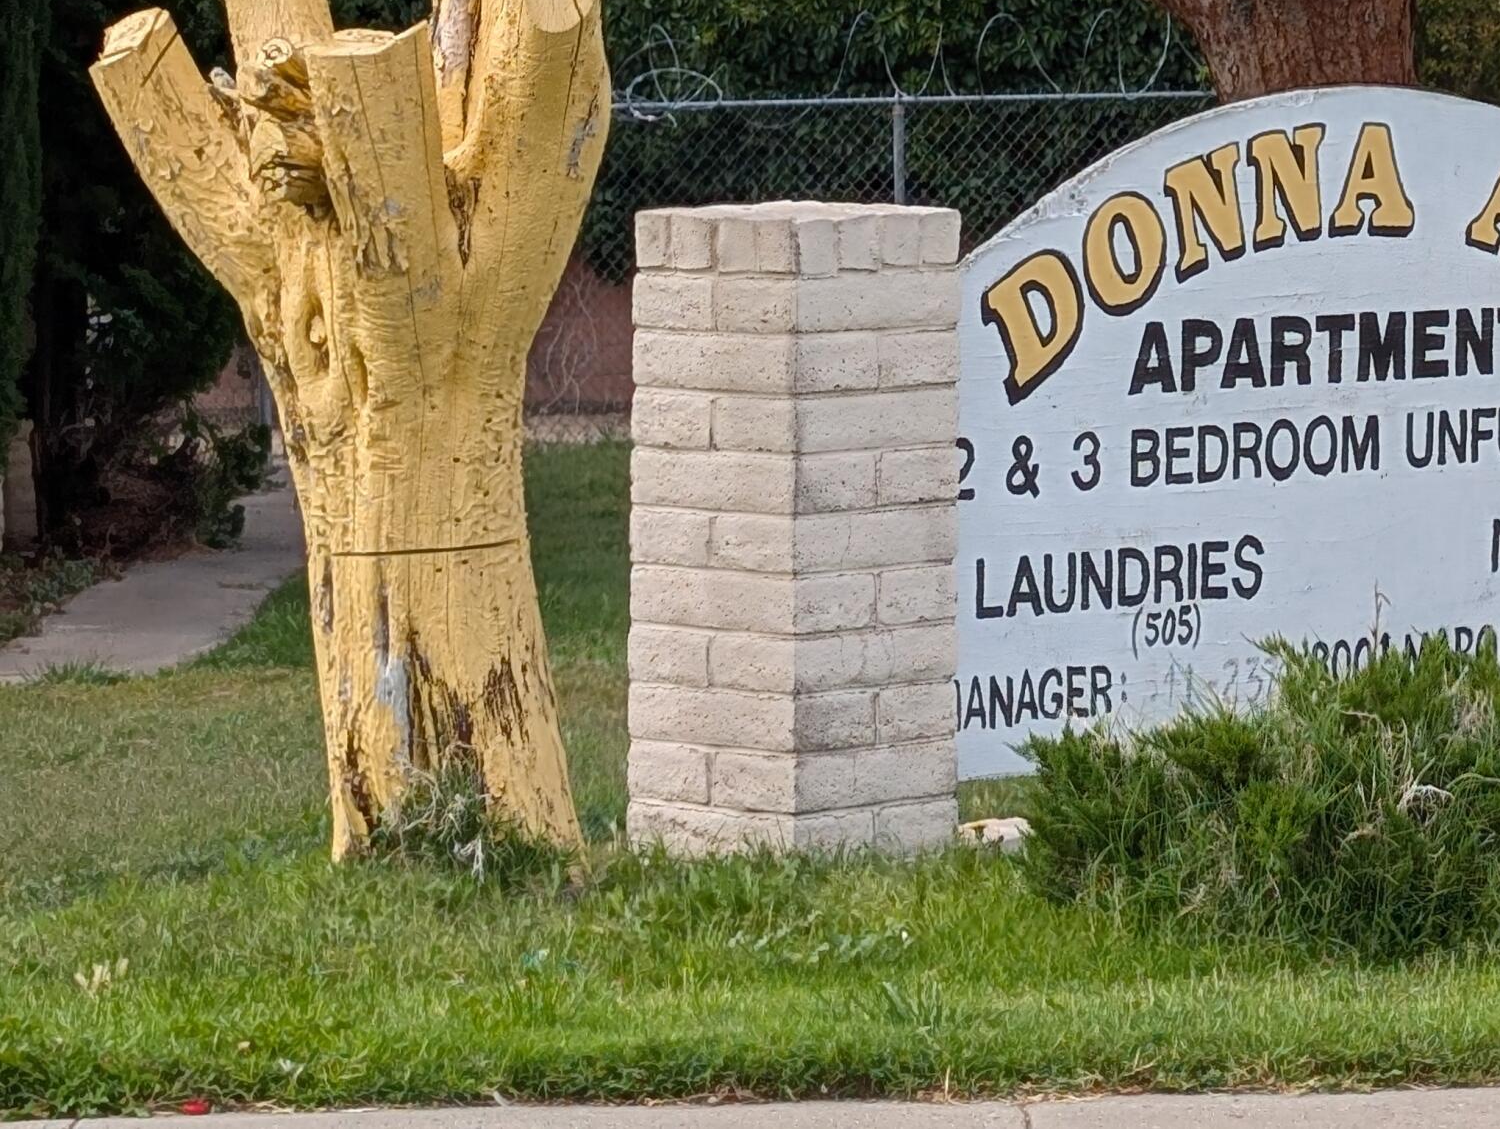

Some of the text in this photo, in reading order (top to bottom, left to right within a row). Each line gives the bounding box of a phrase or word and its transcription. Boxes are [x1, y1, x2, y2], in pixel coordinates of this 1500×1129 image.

[981, 122, 1415, 406] DONNA
[1006, 435, 1040, 498] &
[1071, 430, 1101, 491] 3
[1130, 414, 1379, 487] BEDROOM
[975, 534, 1265, 619] LAUNDRIES
[1132, 604, 1201, 660] (505)
[954, 665, 1128, 732] ANAGER:
